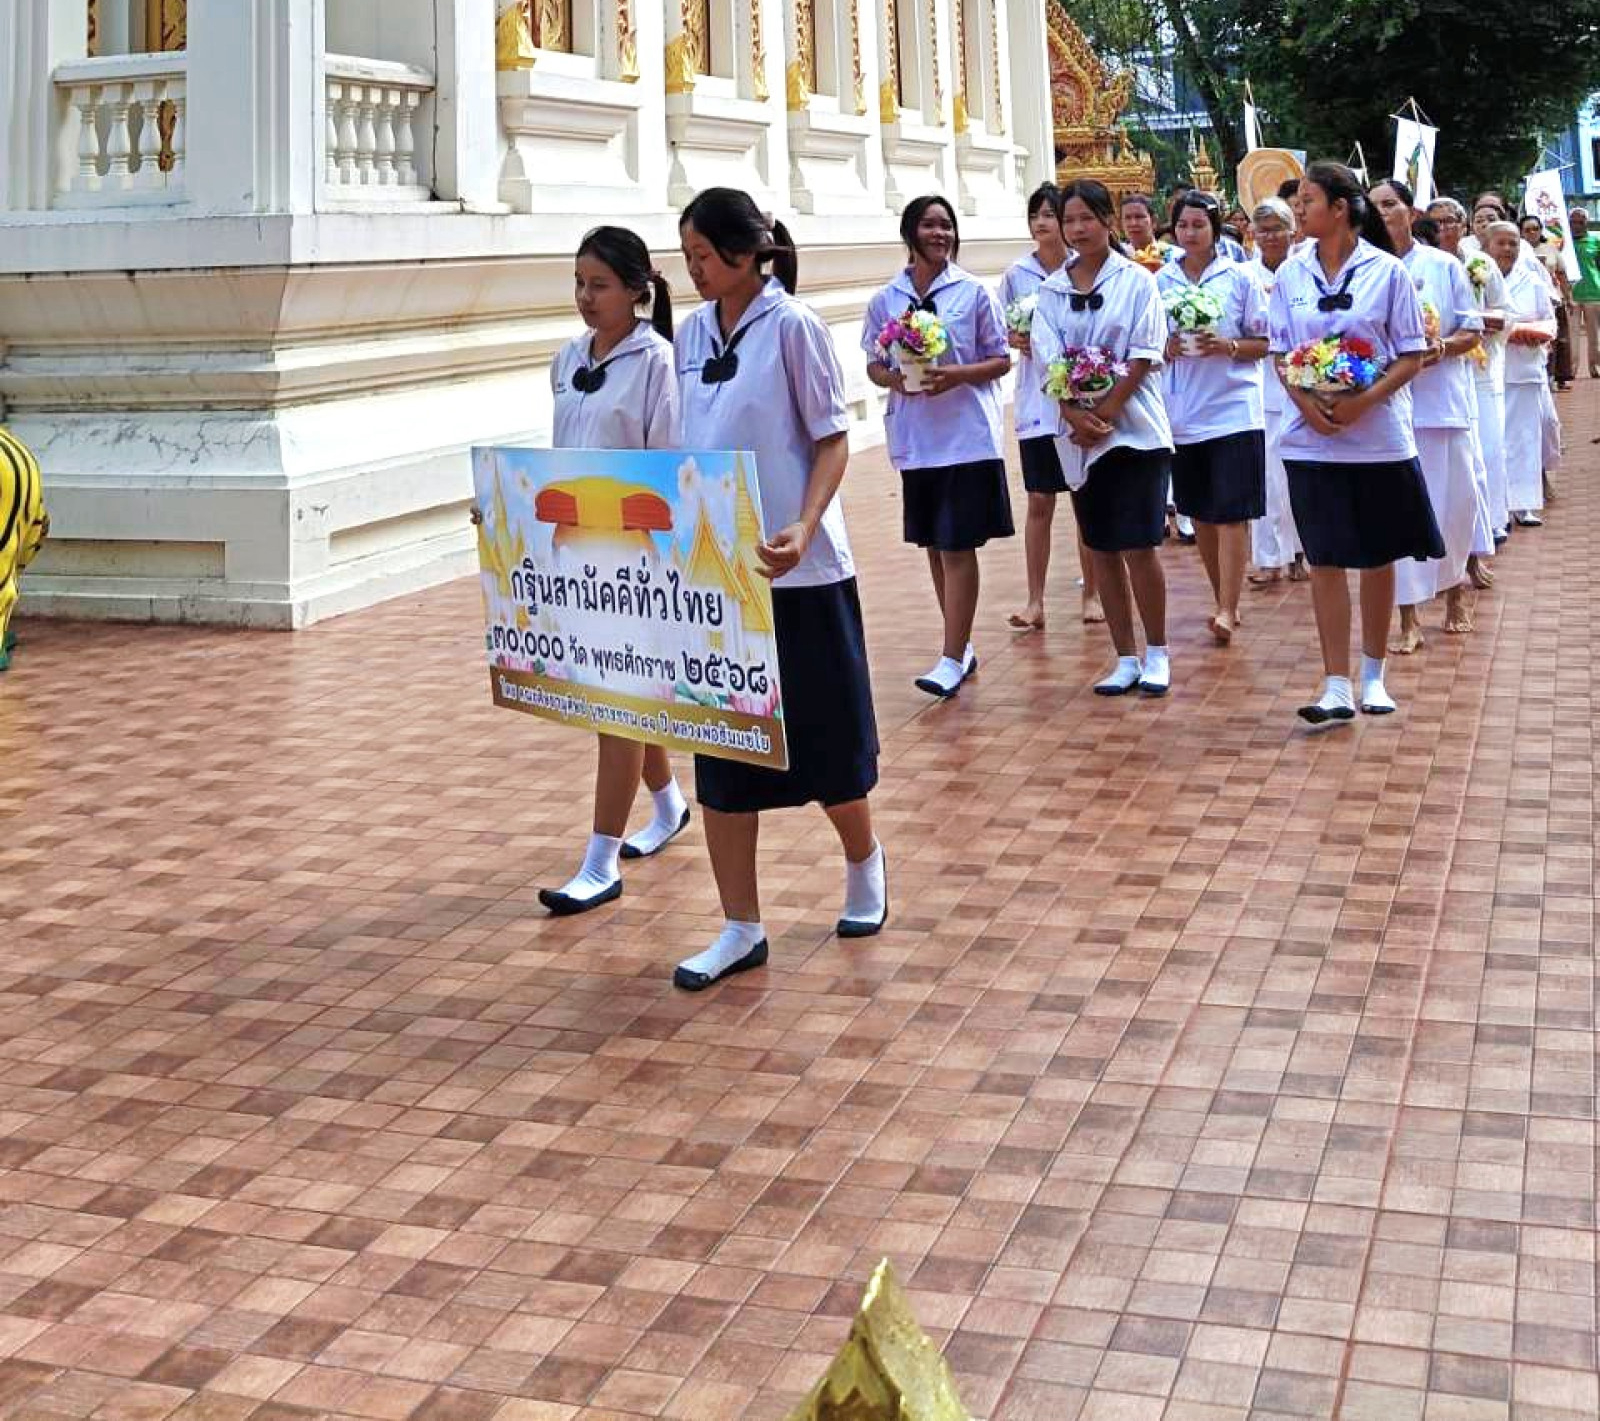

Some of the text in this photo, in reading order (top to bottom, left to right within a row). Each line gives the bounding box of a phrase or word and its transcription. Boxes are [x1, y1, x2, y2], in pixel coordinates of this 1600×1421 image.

[511, 555, 723, 626] กฐินสามัคคีทั่วไทย
[569, 634, 588, 666] วัด
[591, 643, 677, 681] พุทธศักราช
[682, 650, 769, 695] ๒๕๖๘
